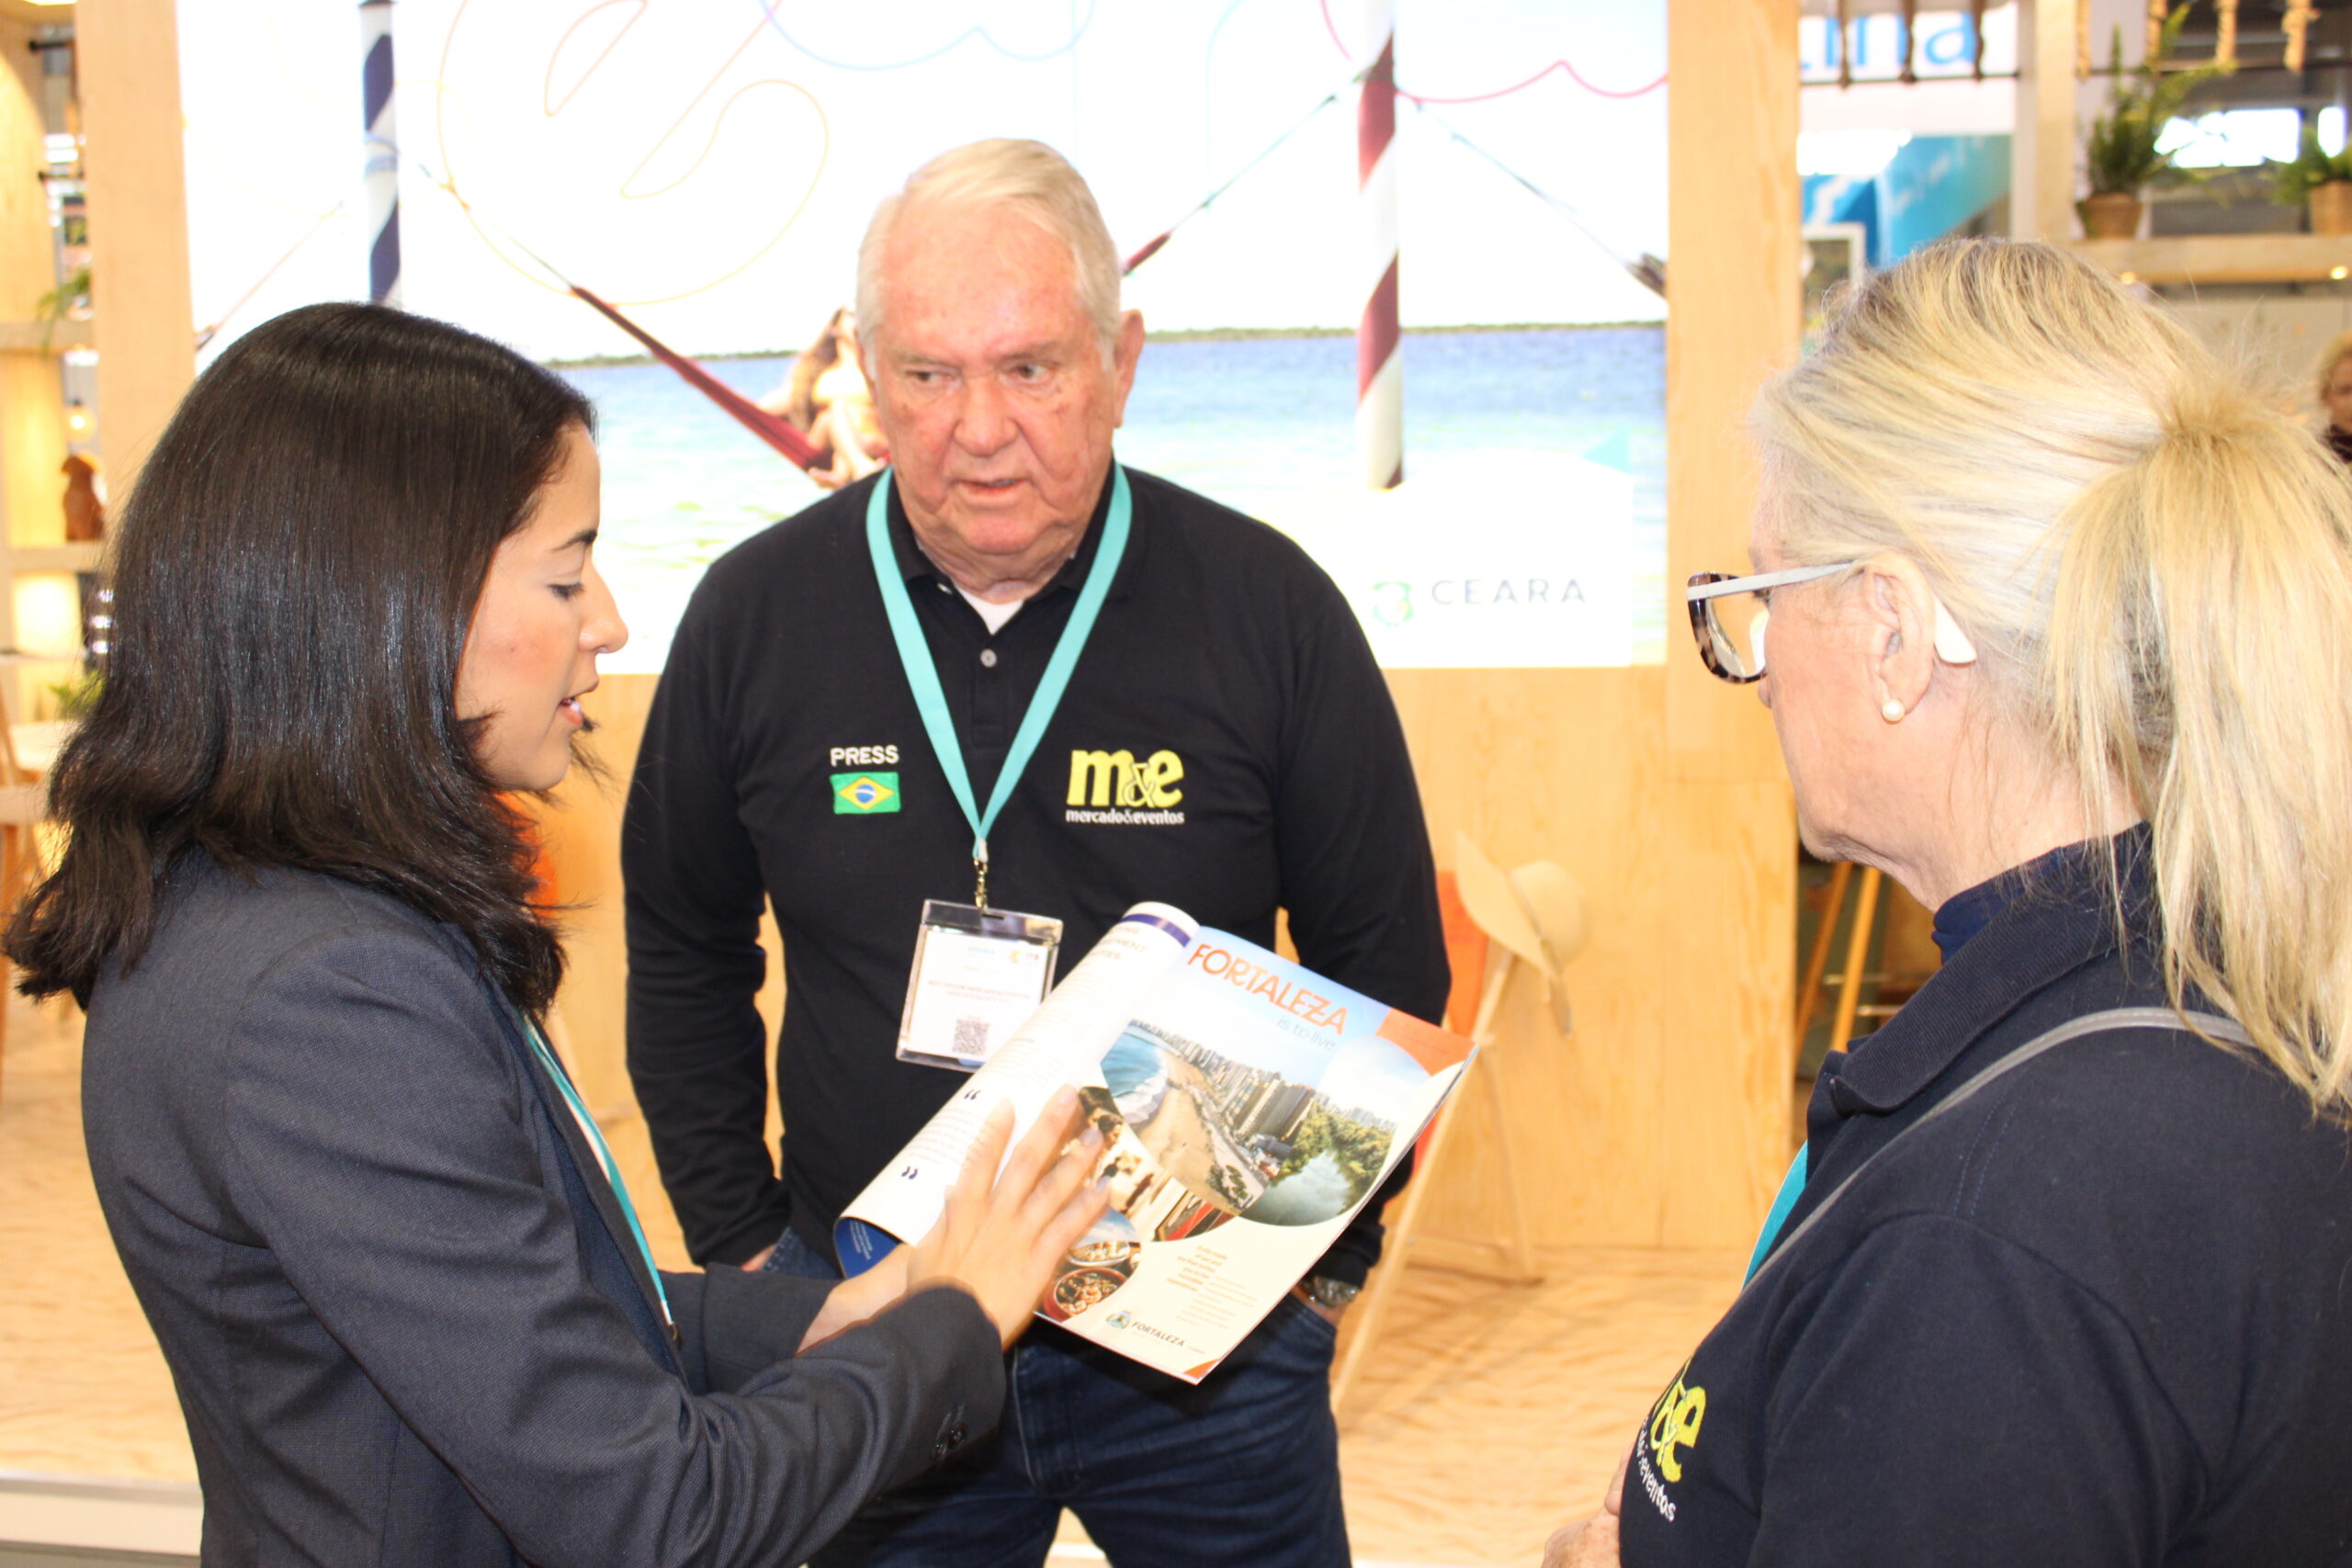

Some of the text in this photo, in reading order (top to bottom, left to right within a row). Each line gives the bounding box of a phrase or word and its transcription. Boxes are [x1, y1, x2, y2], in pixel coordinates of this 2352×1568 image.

[830, 745, 899, 766] PRESS
[1066, 749, 1184, 807] m&e
[1066, 808, 1185, 825] mercado&eventos
[1187, 942, 1350, 1035] FORTALEZA
[1277, 1014, 1336, 1051] is to live
[1132, 1321, 1185, 1348] FORTALEZA
